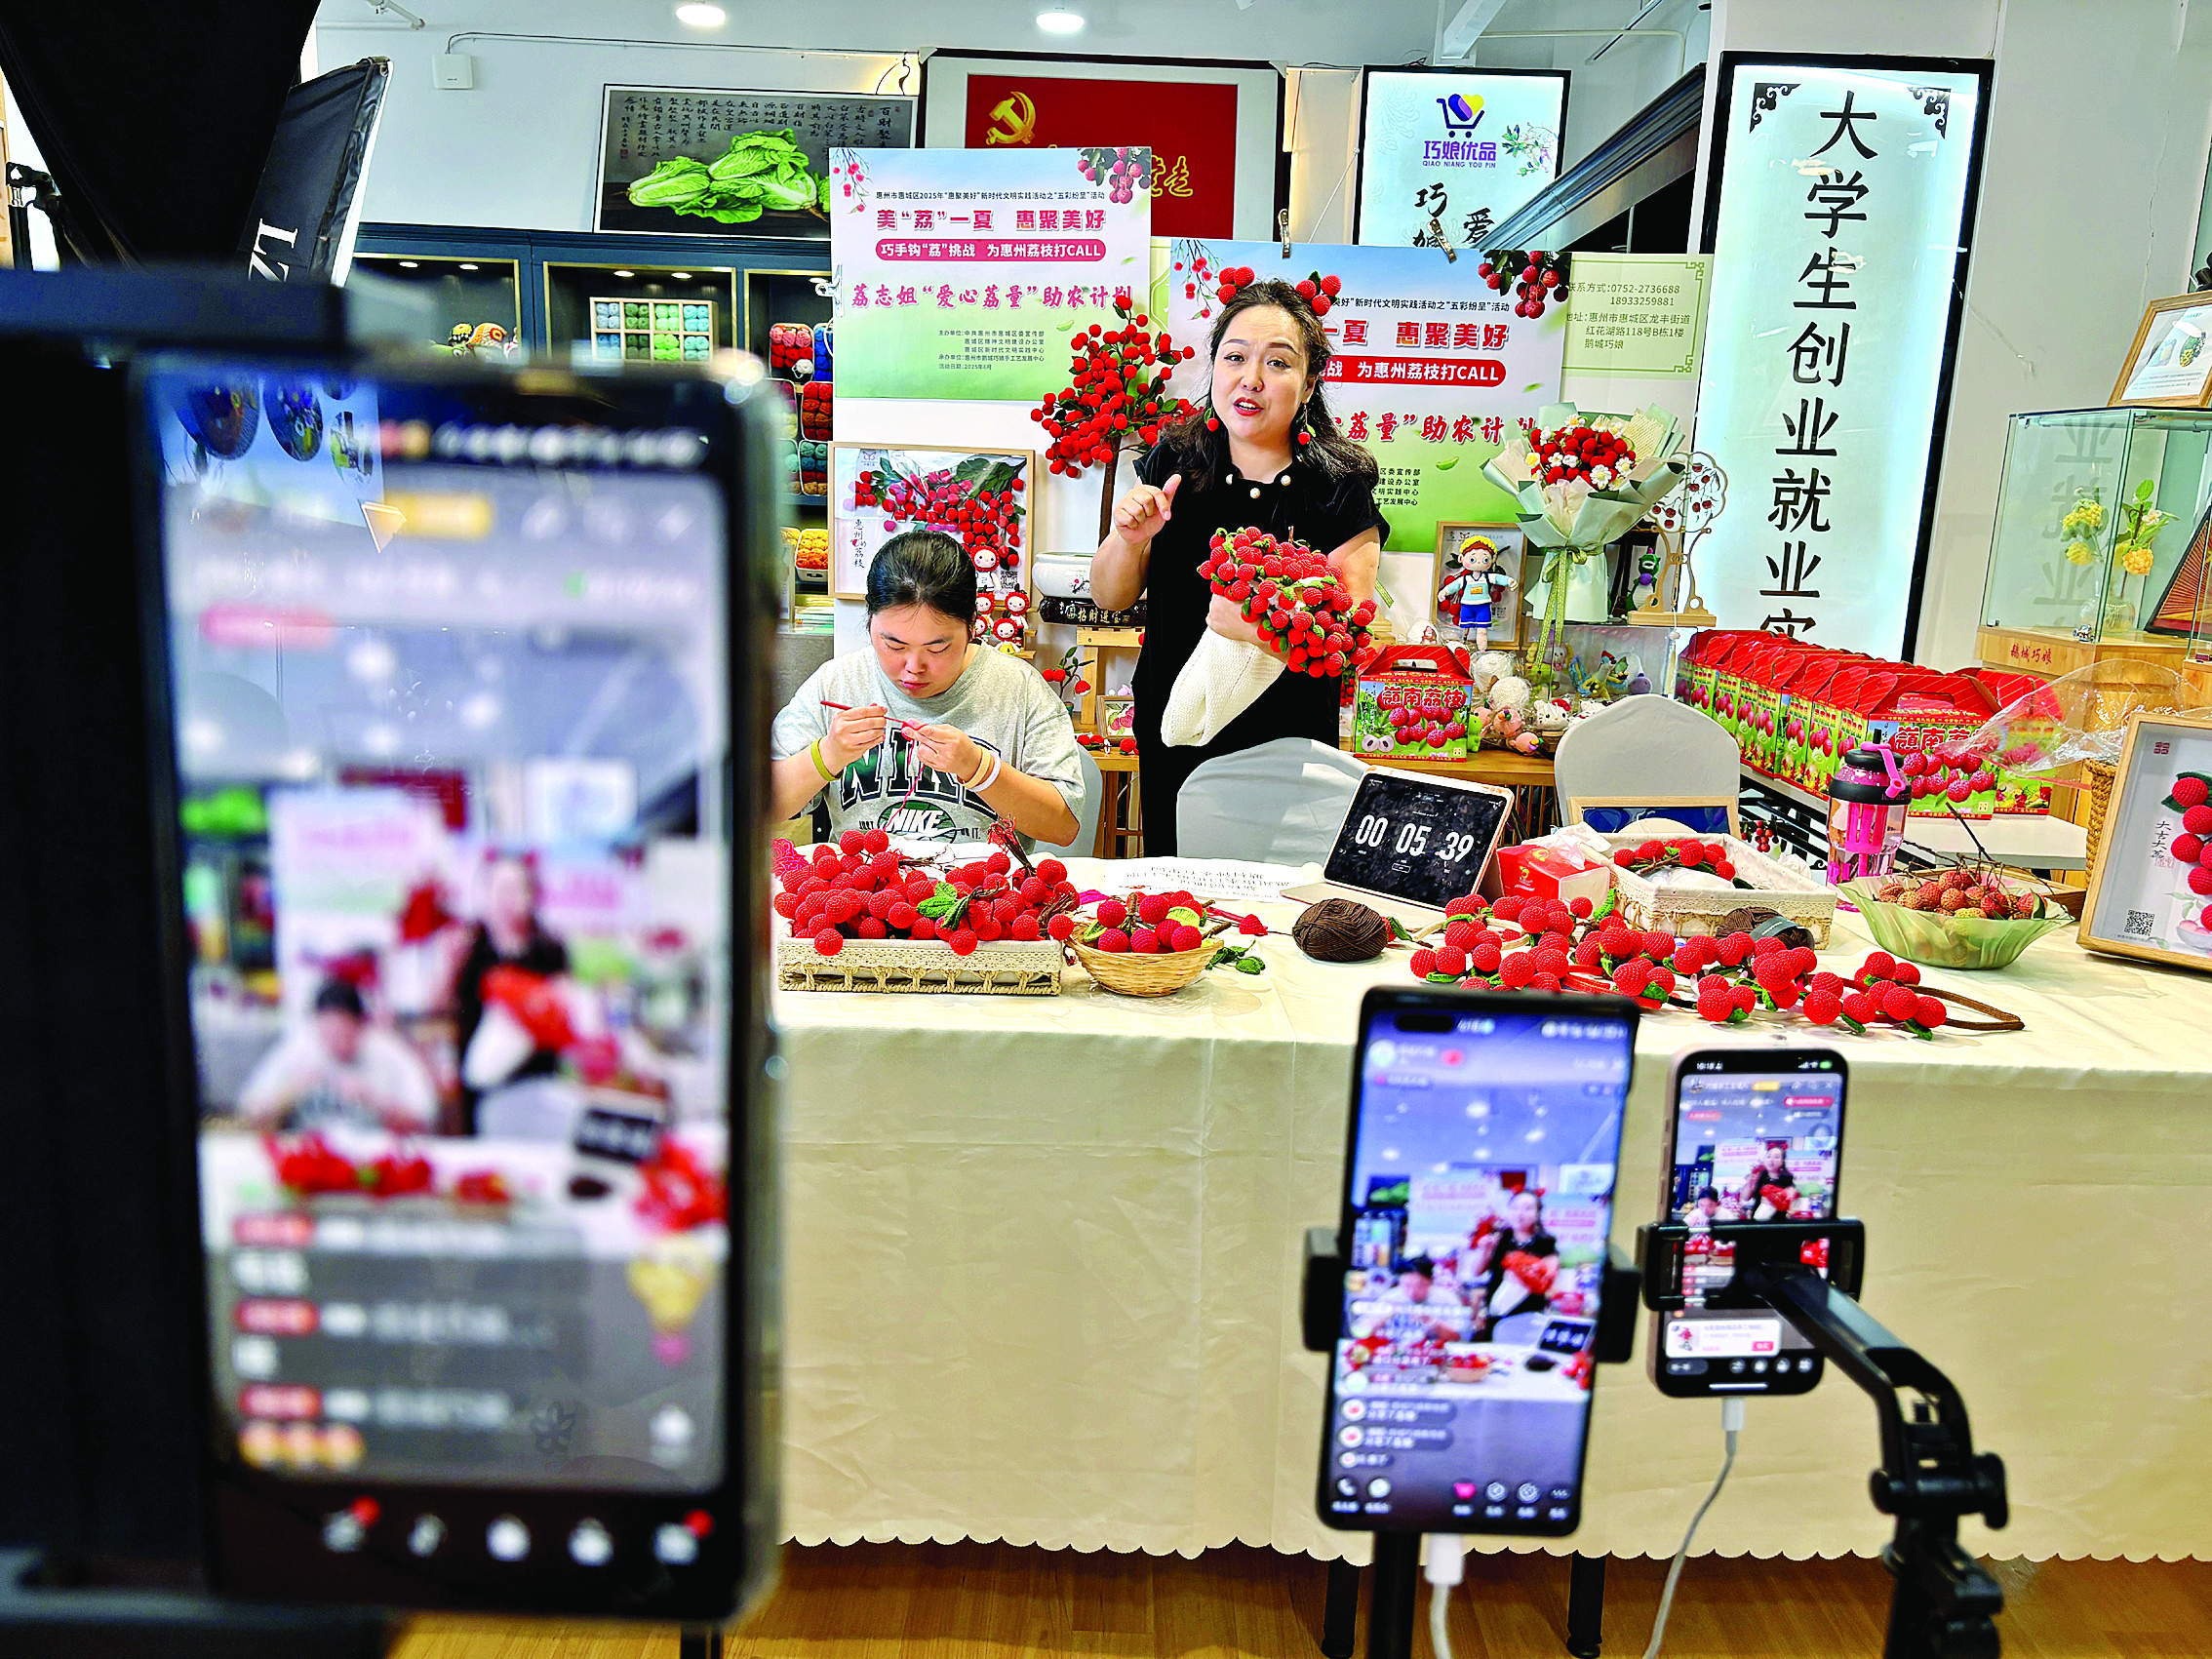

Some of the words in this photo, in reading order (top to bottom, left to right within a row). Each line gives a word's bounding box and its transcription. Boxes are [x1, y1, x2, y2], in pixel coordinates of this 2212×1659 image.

[1423, 140, 1496, 161] 巧娘优品
[1422, 160, 1442, 169] QIAO
[877, 209, 993, 231] 美“荔”一夏
[1016, 209, 1105, 230] 惠聚美好
[881, 243, 976, 257] 巧手钩“荔”挑战
[987, 243, 1101, 257] 为惠州荔枝打CALL
[1610, 296, 1675, 306] 18933259881
[1397, 321, 1510, 348] 惠聚美好
[1585, 326, 1685, 337] 红花湖路118号B栋1楼
[1357, 361, 1499, 381] 为惠州荔枝打CALL
[886, 809, 945, 832] NIKE
[1355, 814, 1389, 848] 00
[1395, 823, 1433, 856] 05
[1439, 831, 1475, 863] 39
